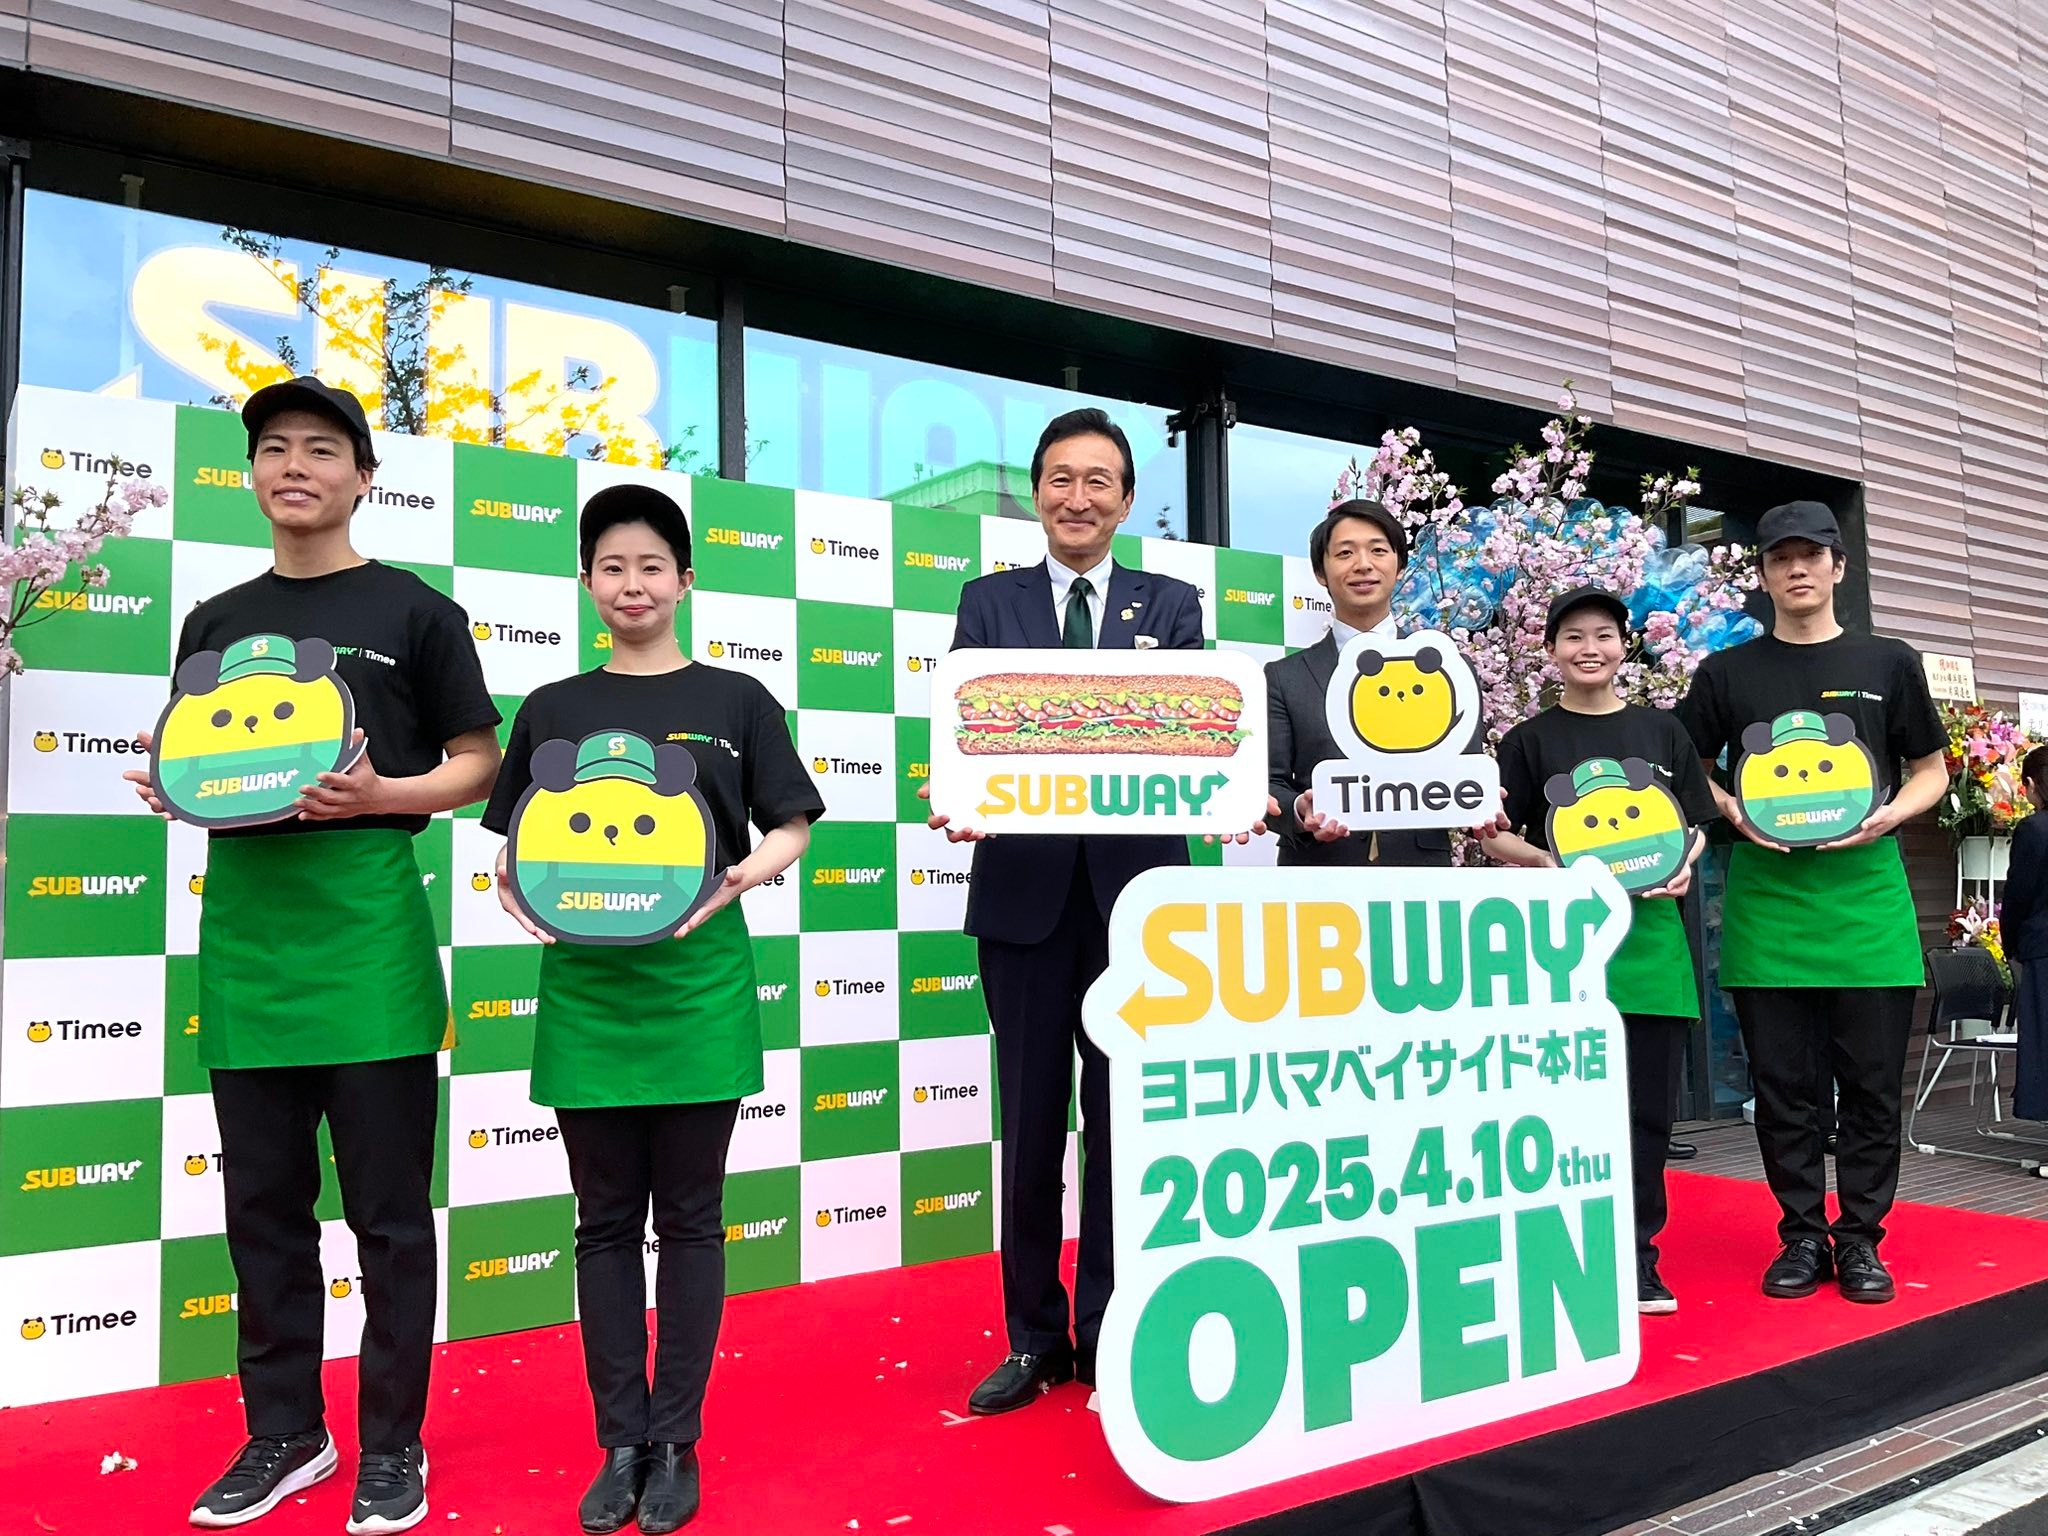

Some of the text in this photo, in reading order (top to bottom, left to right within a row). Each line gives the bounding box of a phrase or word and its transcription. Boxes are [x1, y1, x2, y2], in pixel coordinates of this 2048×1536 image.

[69, 451, 152, 478] Timee
[193, 467, 253, 490] SUB
[368, 486, 435, 510] Timee
[470, 499, 563, 524] SUBWAY
[705, 528, 783, 549] SUBWAY
[828, 540, 879, 560] Timee
[904, 552, 971, 571] SUBWAY
[35, 590, 152, 615] SUBWAY
[1224, 589, 1275, 606] SUBWAY
[1305, 597, 1331, 613] Time
[495, 624, 561, 645] Timee
[727, 643, 782, 661] Timee
[810, 648, 882, 667] SUBWAY
[831, 758, 882, 774] Timee
[196, 768, 300, 799] SUBWAY
[974, 771, 1230, 819] SUBWAY
[1331, 775, 1484, 813] Timee
[1774, 809, 1846, 827] SUBWAY
[1607, 852, 1664, 874] UBWAY
[27, 875, 148, 898] SUBWAY
[812, 867, 885, 885] SUBWAY
[556, 892, 661, 912] SUBWAY
[1116, 887, 1611, 1041] SUBWAY
[834, 981, 884, 996] Timee
[911, 974, 978, 994] SUBWAY
[467, 997, 538, 1020] SUBWA
[57, 1020, 142, 1041] Timee
[1142, 1027, 1607, 1122] ヨコハマベイサイド本店
[813, 1088, 887, 1111] SUBWAY
[930, 1084, 978, 1101] Timee
[740, 1104, 786, 1120] imee
[492, 1127, 559, 1146] Timee
[20, 1160, 142, 1191] SUBWAY
[1140, 1115, 1612, 1250] 2025.4.10 thu
[834, 1205, 887, 1224] Timee
[913, 1190, 981, 1216] SUBWAY
[724, 1217, 788, 1241] UBWAY
[464, 1249, 560, 1281] SUBWAY
[179, 1293, 237, 1319] SUB
[51, 1310, 137, 1335] Timee
[1131, 1195, 1621, 1461] OPEN
